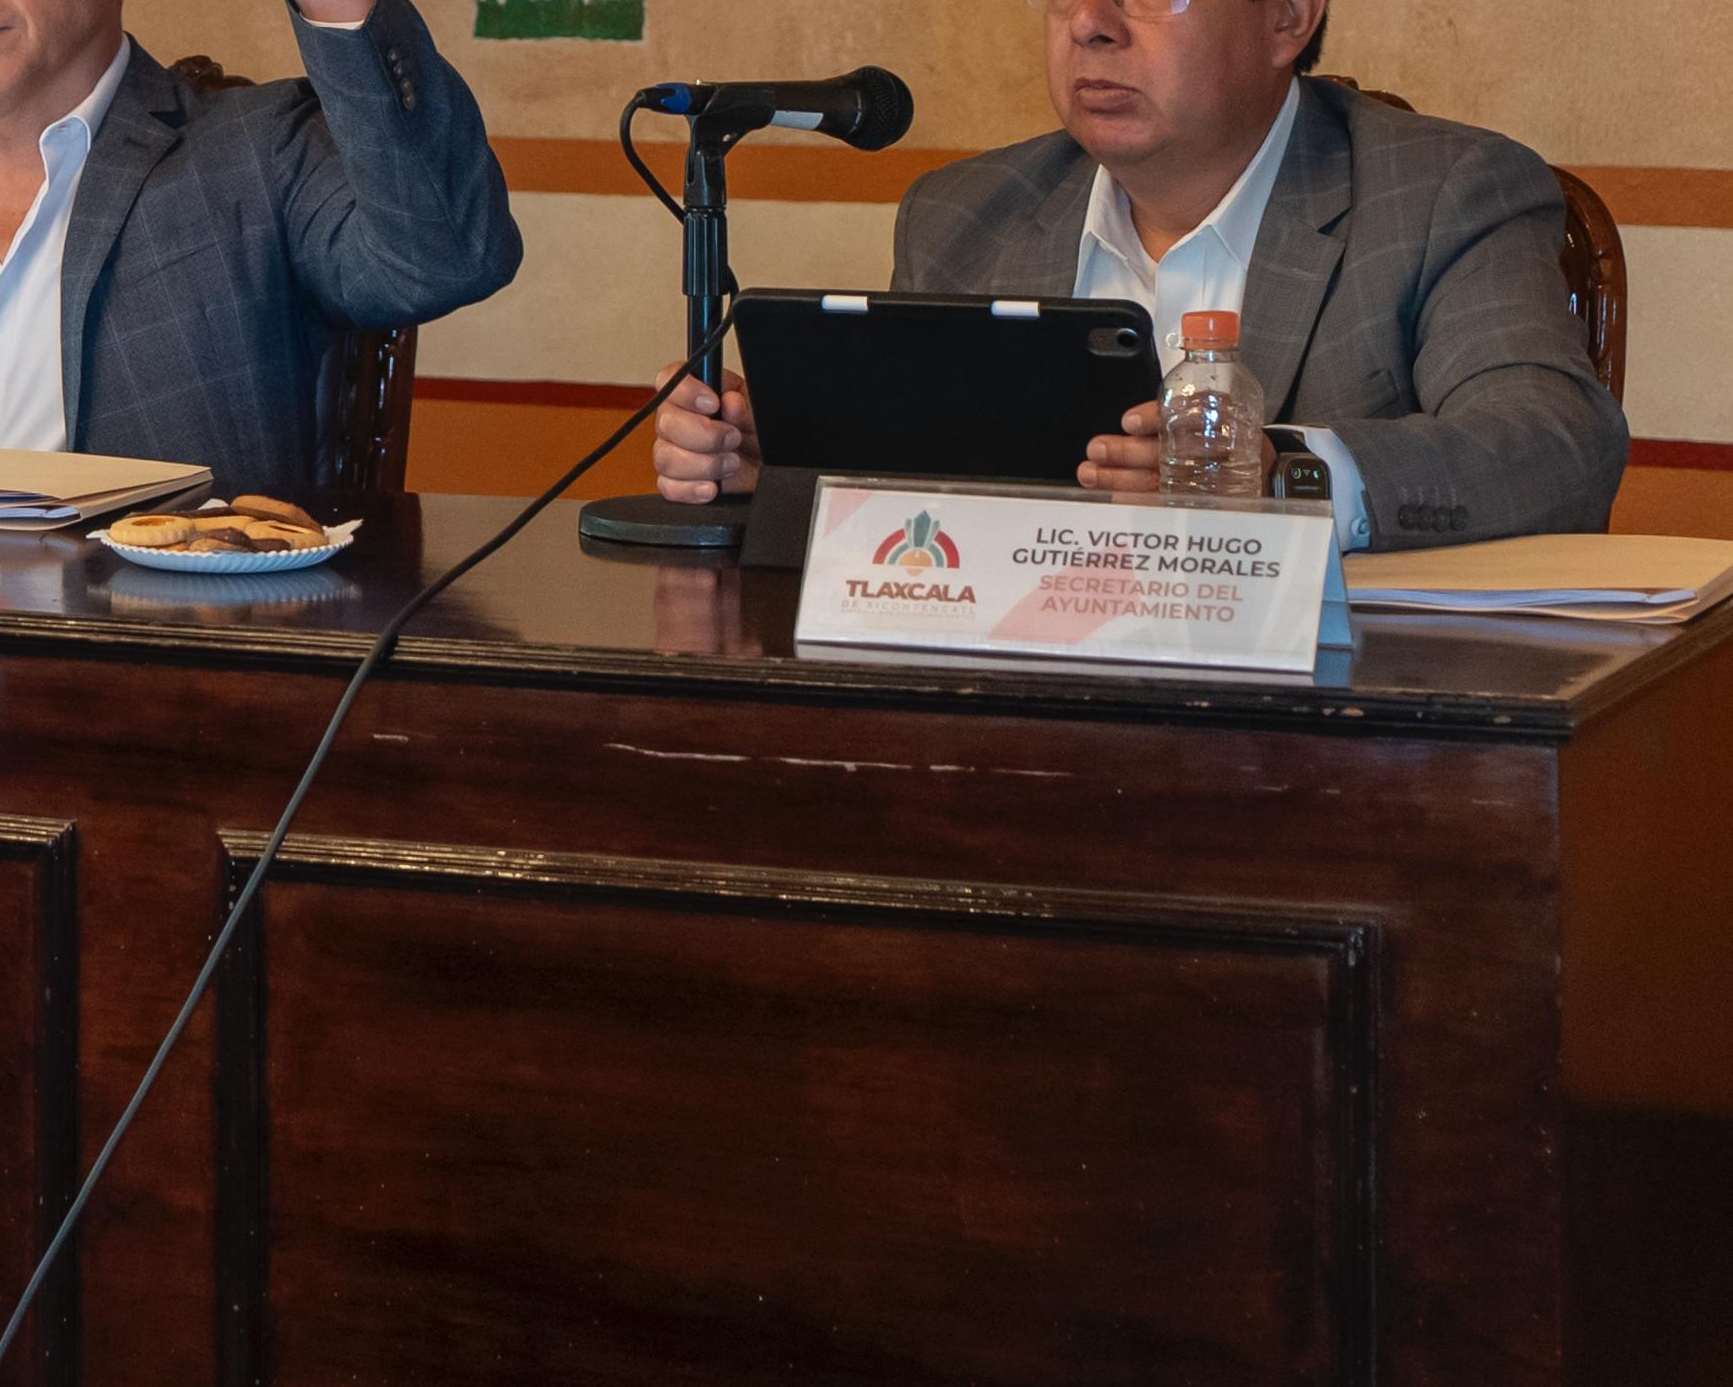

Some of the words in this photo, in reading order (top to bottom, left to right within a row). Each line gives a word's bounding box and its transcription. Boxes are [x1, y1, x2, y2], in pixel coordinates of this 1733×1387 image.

[1036, 528, 1079, 546] LIC.
[1088, 530, 1179, 551] VICTOR
[1187, 536, 1262, 556] HUGO
[1012, 547, 1151, 572] GUTIÉRREZ
[1158, 556, 1280, 578] MORALES
[846, 580, 976, 603] TLAXCALA
[1039, 575, 1189, 599] SECRETARIO
[1197, 583, 1244, 602] DEL
[1041, 596, 1235, 623] AYUNTAMIENTO
